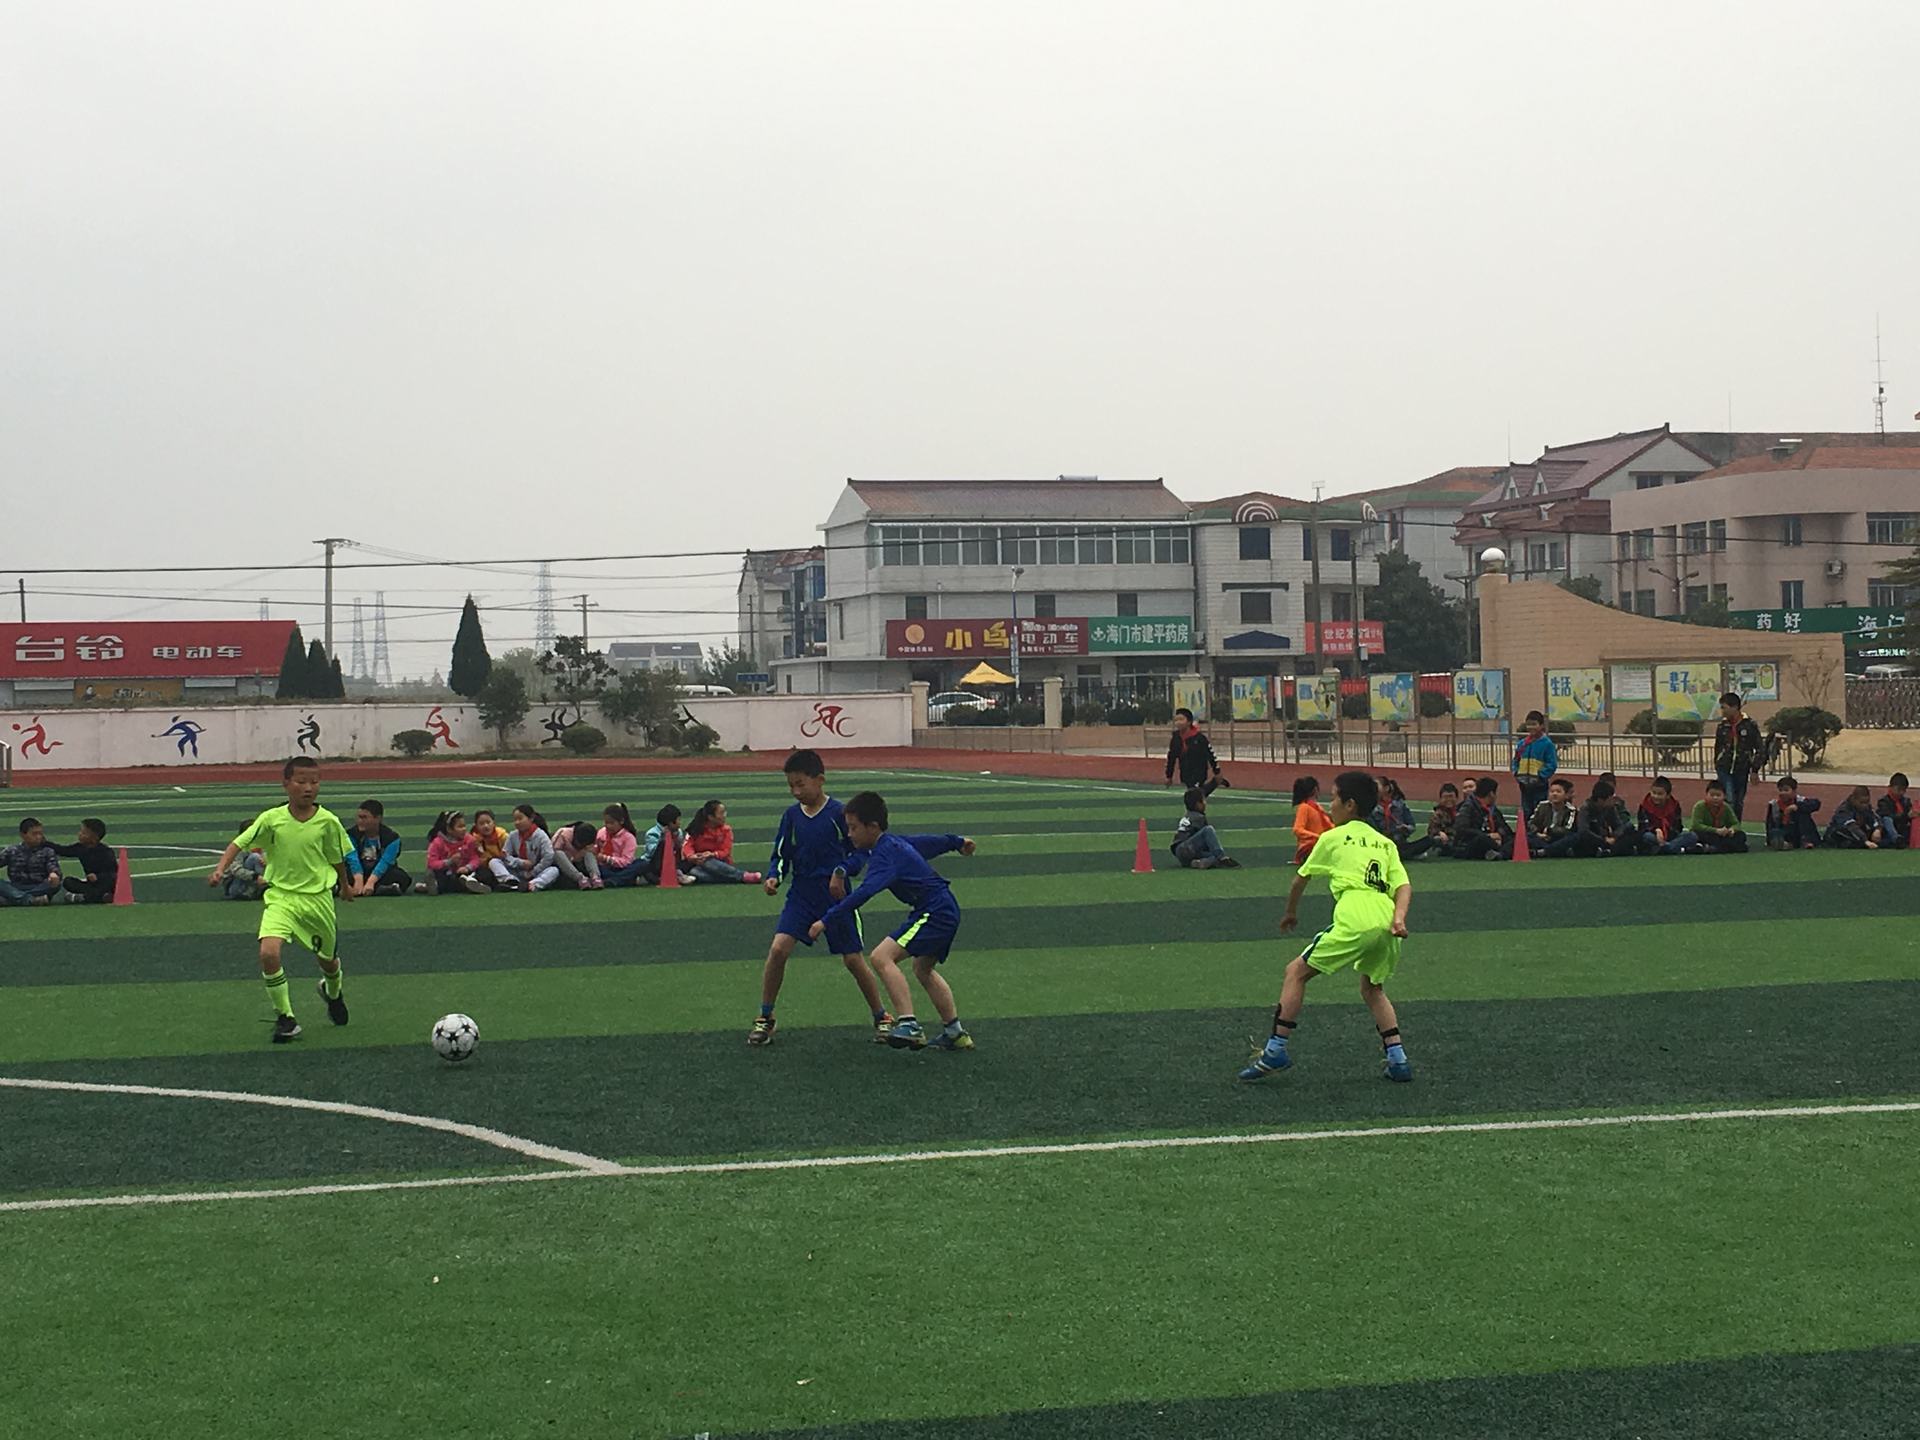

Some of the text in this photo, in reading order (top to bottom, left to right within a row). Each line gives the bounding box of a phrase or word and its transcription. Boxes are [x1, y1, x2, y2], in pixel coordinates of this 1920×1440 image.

[945, 621, 1009, 651] 小鸟
[1021, 633, 1079, 645] 电动车
[1106, 624, 1188, 644] 海门市建平药房
[16, 635, 242, 662] 台铃 电动车
[1551, 676, 1572, 697] 生活
[1365, 859, 1391, 893] 4
[311, 934, 323, 953] 9
